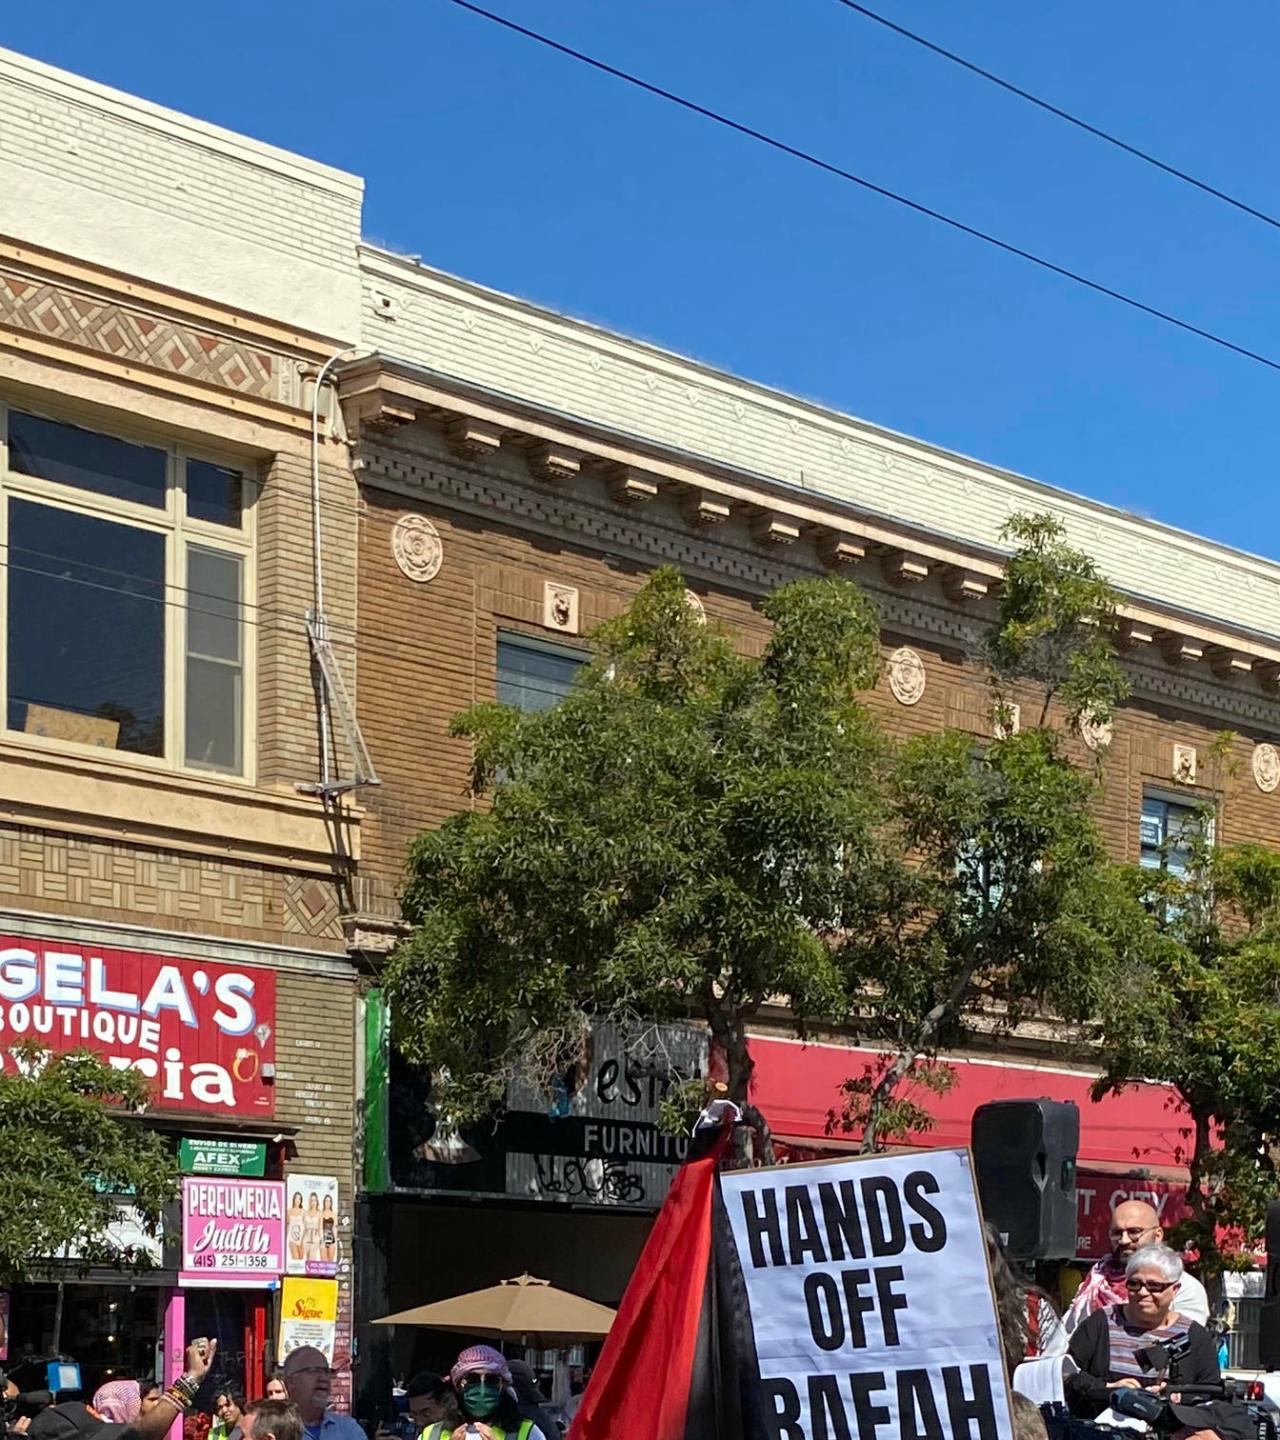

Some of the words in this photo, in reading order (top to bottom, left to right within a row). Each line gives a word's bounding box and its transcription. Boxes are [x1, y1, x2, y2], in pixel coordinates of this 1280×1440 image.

[584, 1124, 689, 1158] FURNITU
[193, 1152, 240, 1165] AFEX
[189, 1184, 281, 1220] PERFUMERIA
[740, 1170, 947, 1268] HANDS
[193, 1220, 270, 1254] Judith
[193, 1254, 217, 1268] (415)
[221, 1254, 268, 1268] 251-1358
[292, 1300, 324, 1320] Sigue
[804, 1265, 908, 1351] OFF
